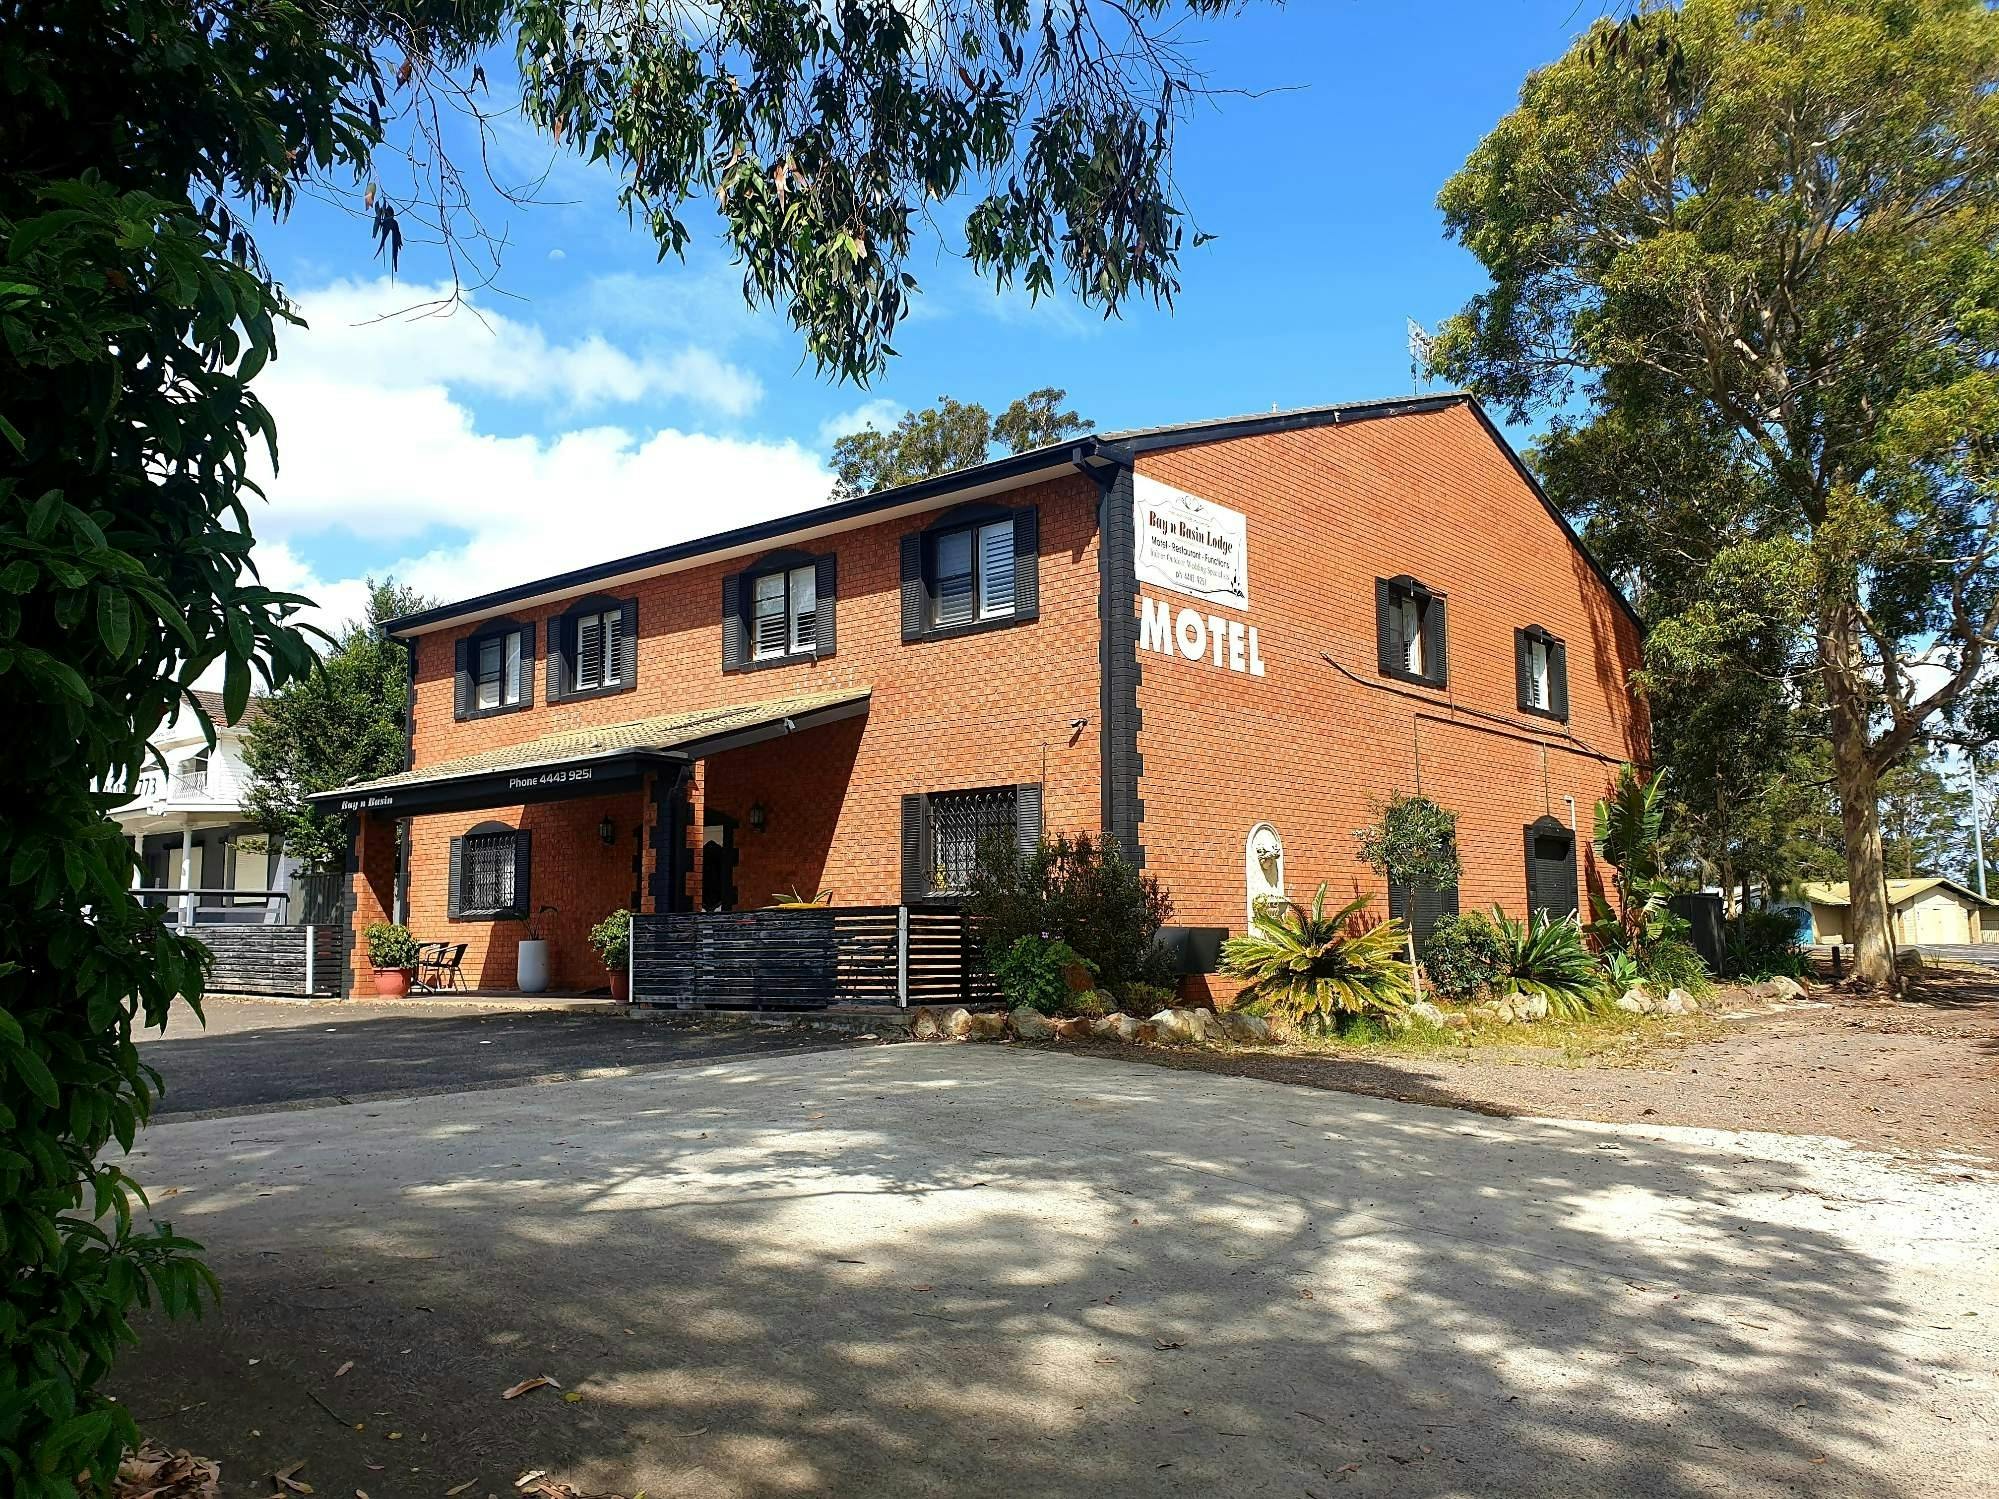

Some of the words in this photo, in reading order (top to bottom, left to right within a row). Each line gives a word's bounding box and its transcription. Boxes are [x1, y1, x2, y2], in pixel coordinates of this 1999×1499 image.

[1149, 510, 1168, 535] Bay
[1170, 522, 1176, 534] n
[1179, 521, 1205, 544] Basin
[1206, 531, 1233, 556] Lodge
[1151, 536, 1168, 549] Motel
[1172, 542, 1201, 560] Restaurant
[1204, 554, 1230, 568] Functions
[1140, 596, 1264, 677] MOTEL
[509, 777, 538, 789] Phone
[540, 772, 567, 784] 4443
[568, 768, 592, 780] 9251
[341, 800, 358, 810] Bay
[360, 800, 366, 808] n
[368, 796, 393, 806] Basin
